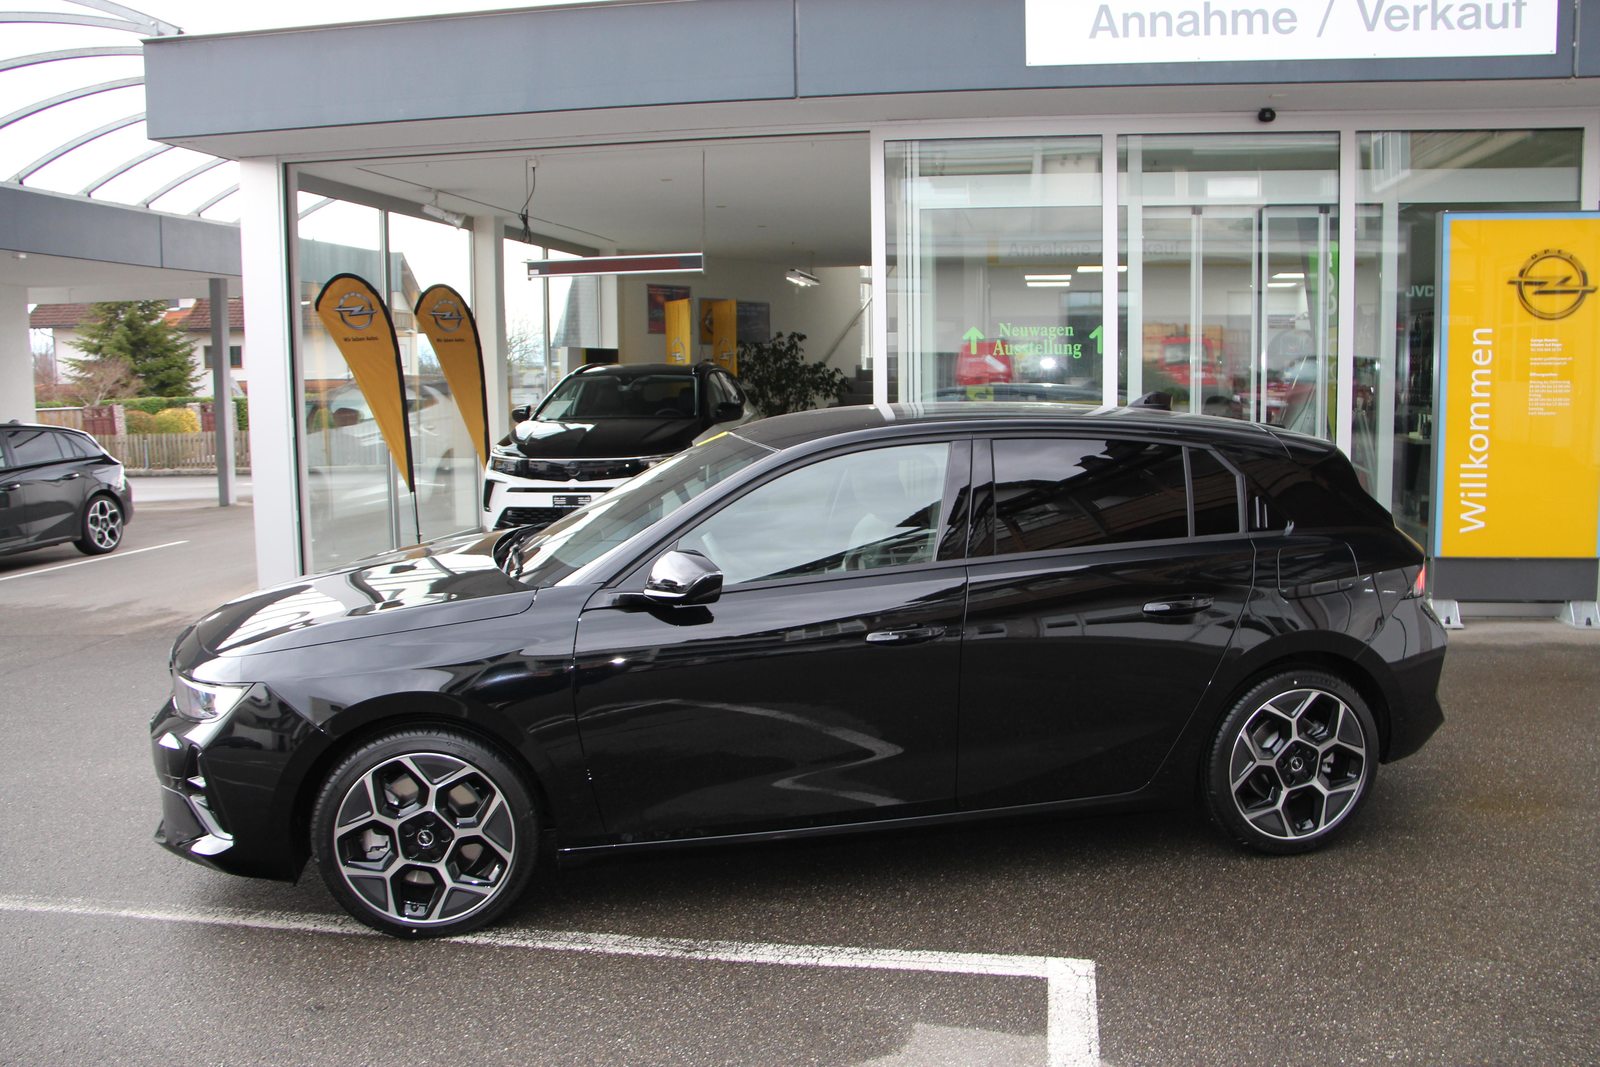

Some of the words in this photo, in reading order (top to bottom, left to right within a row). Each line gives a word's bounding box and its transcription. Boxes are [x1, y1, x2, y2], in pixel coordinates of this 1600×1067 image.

[1089, 1, 1298, 39] Annahme
[1358, 0, 1527, 32] Verkauf
[1406, 285, 1434, 297] JVC
[998, 323, 1075, 339] Neuwagen
[993, 339, 1082, 359] Ausstellung
[1459, 328, 1493, 533] Willkommen
